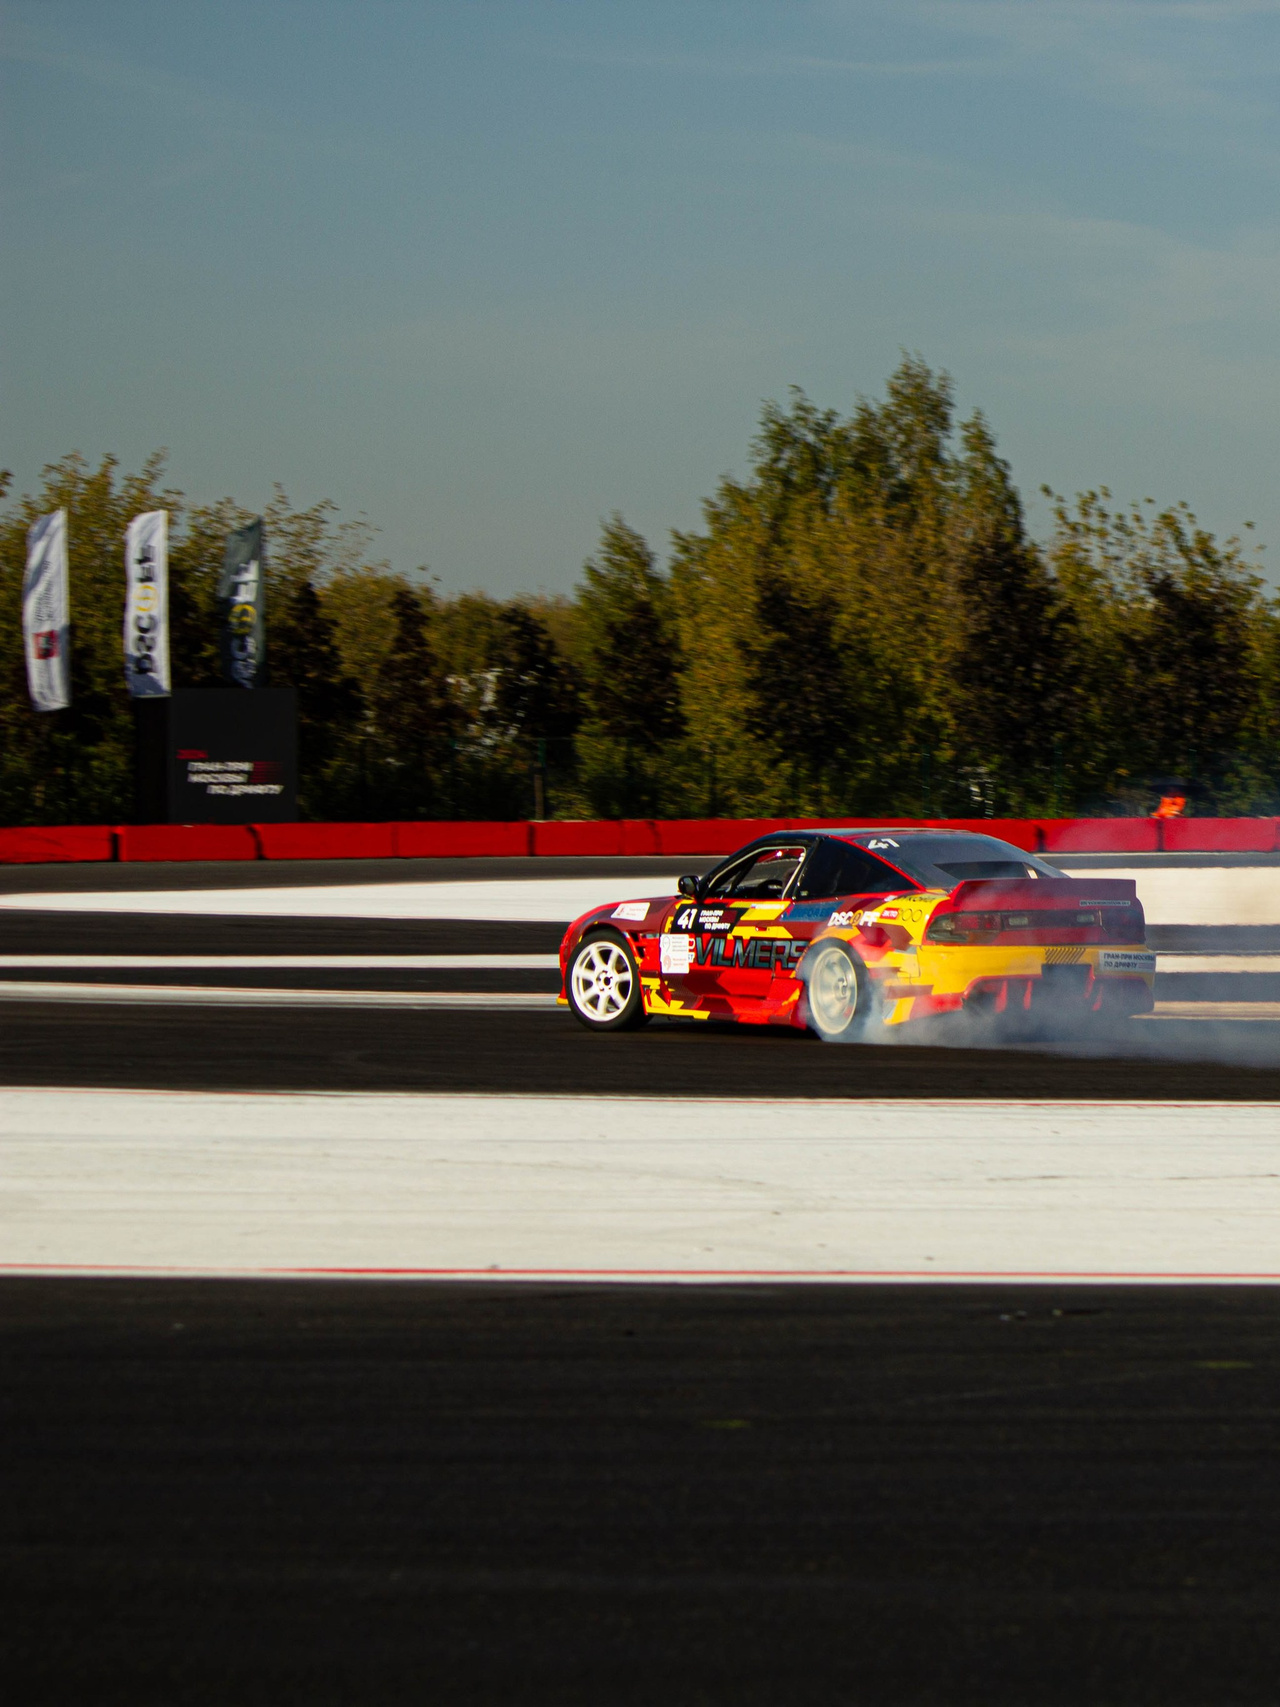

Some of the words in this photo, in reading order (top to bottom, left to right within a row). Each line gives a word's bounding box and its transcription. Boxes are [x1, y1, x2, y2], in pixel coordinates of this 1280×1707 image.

[868, 838, 900, 849] 41
[677, 908, 698, 929] 41
[1114, 961, 1138, 969] ДРИФТУ
